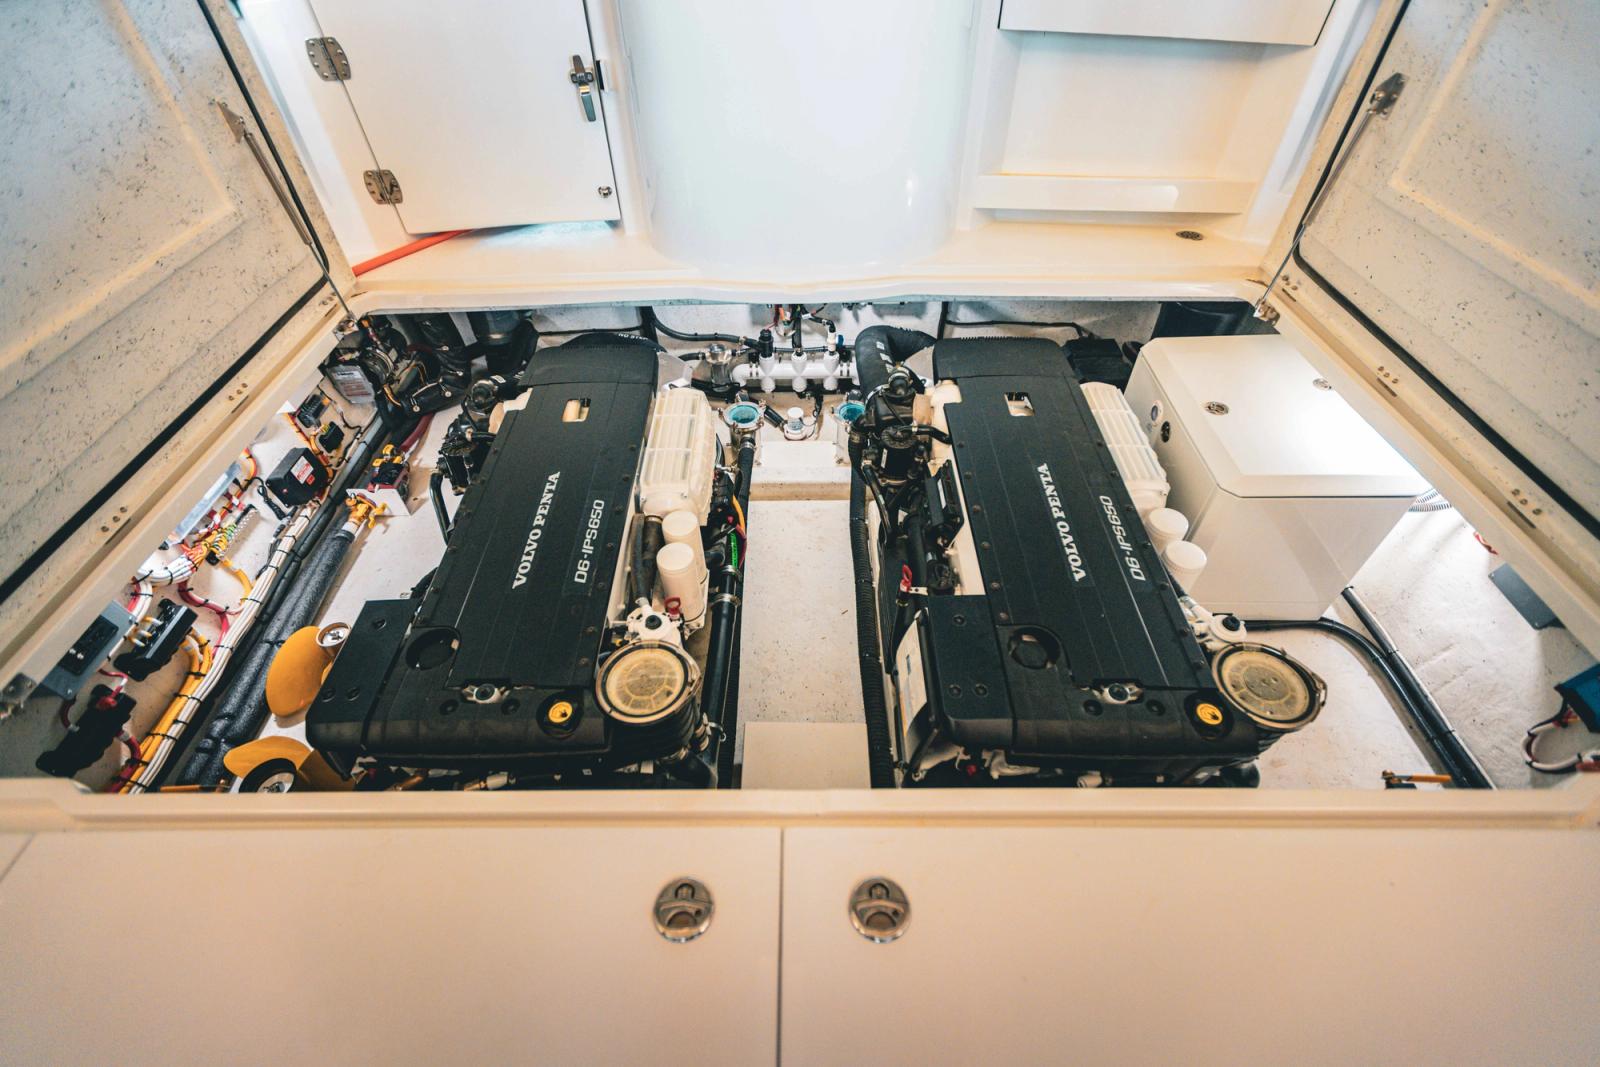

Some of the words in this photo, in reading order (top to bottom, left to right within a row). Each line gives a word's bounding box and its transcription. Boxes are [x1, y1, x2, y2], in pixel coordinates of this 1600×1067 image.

[511, 528, 542, 590] VOLVO
[532, 471, 561, 527] PENTA
[1037, 462, 1066, 519] PENTA
[574, 499, 605, 584] D6-IPS650
[1056, 522, 1087, 582] VOLVO
[1099, 495, 1146, 581] D6-IPS650
